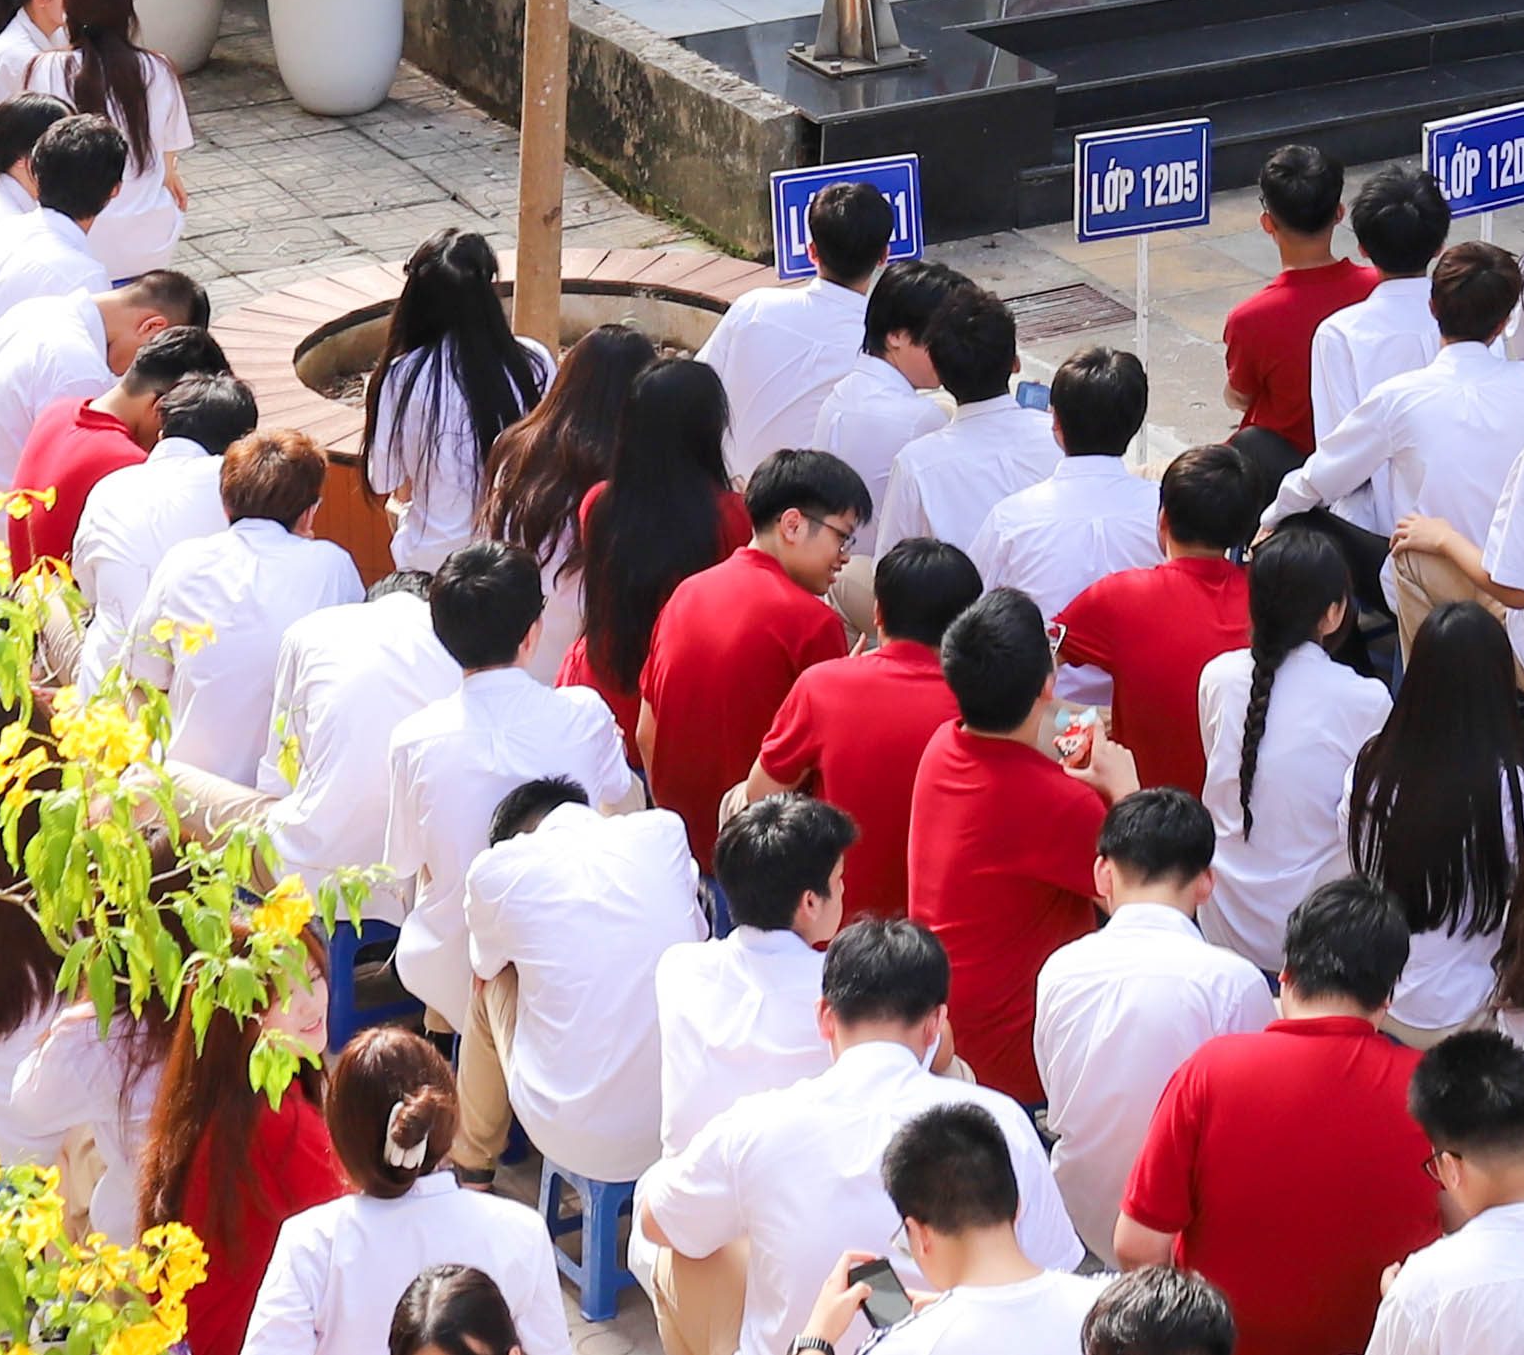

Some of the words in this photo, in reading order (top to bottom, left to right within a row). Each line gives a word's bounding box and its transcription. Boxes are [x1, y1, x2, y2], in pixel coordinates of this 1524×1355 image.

[1090, 158, 1134, 215] LỚP
[1141, 159, 1198, 208] 12D5
[1438, 140, 1481, 202] LỚP
